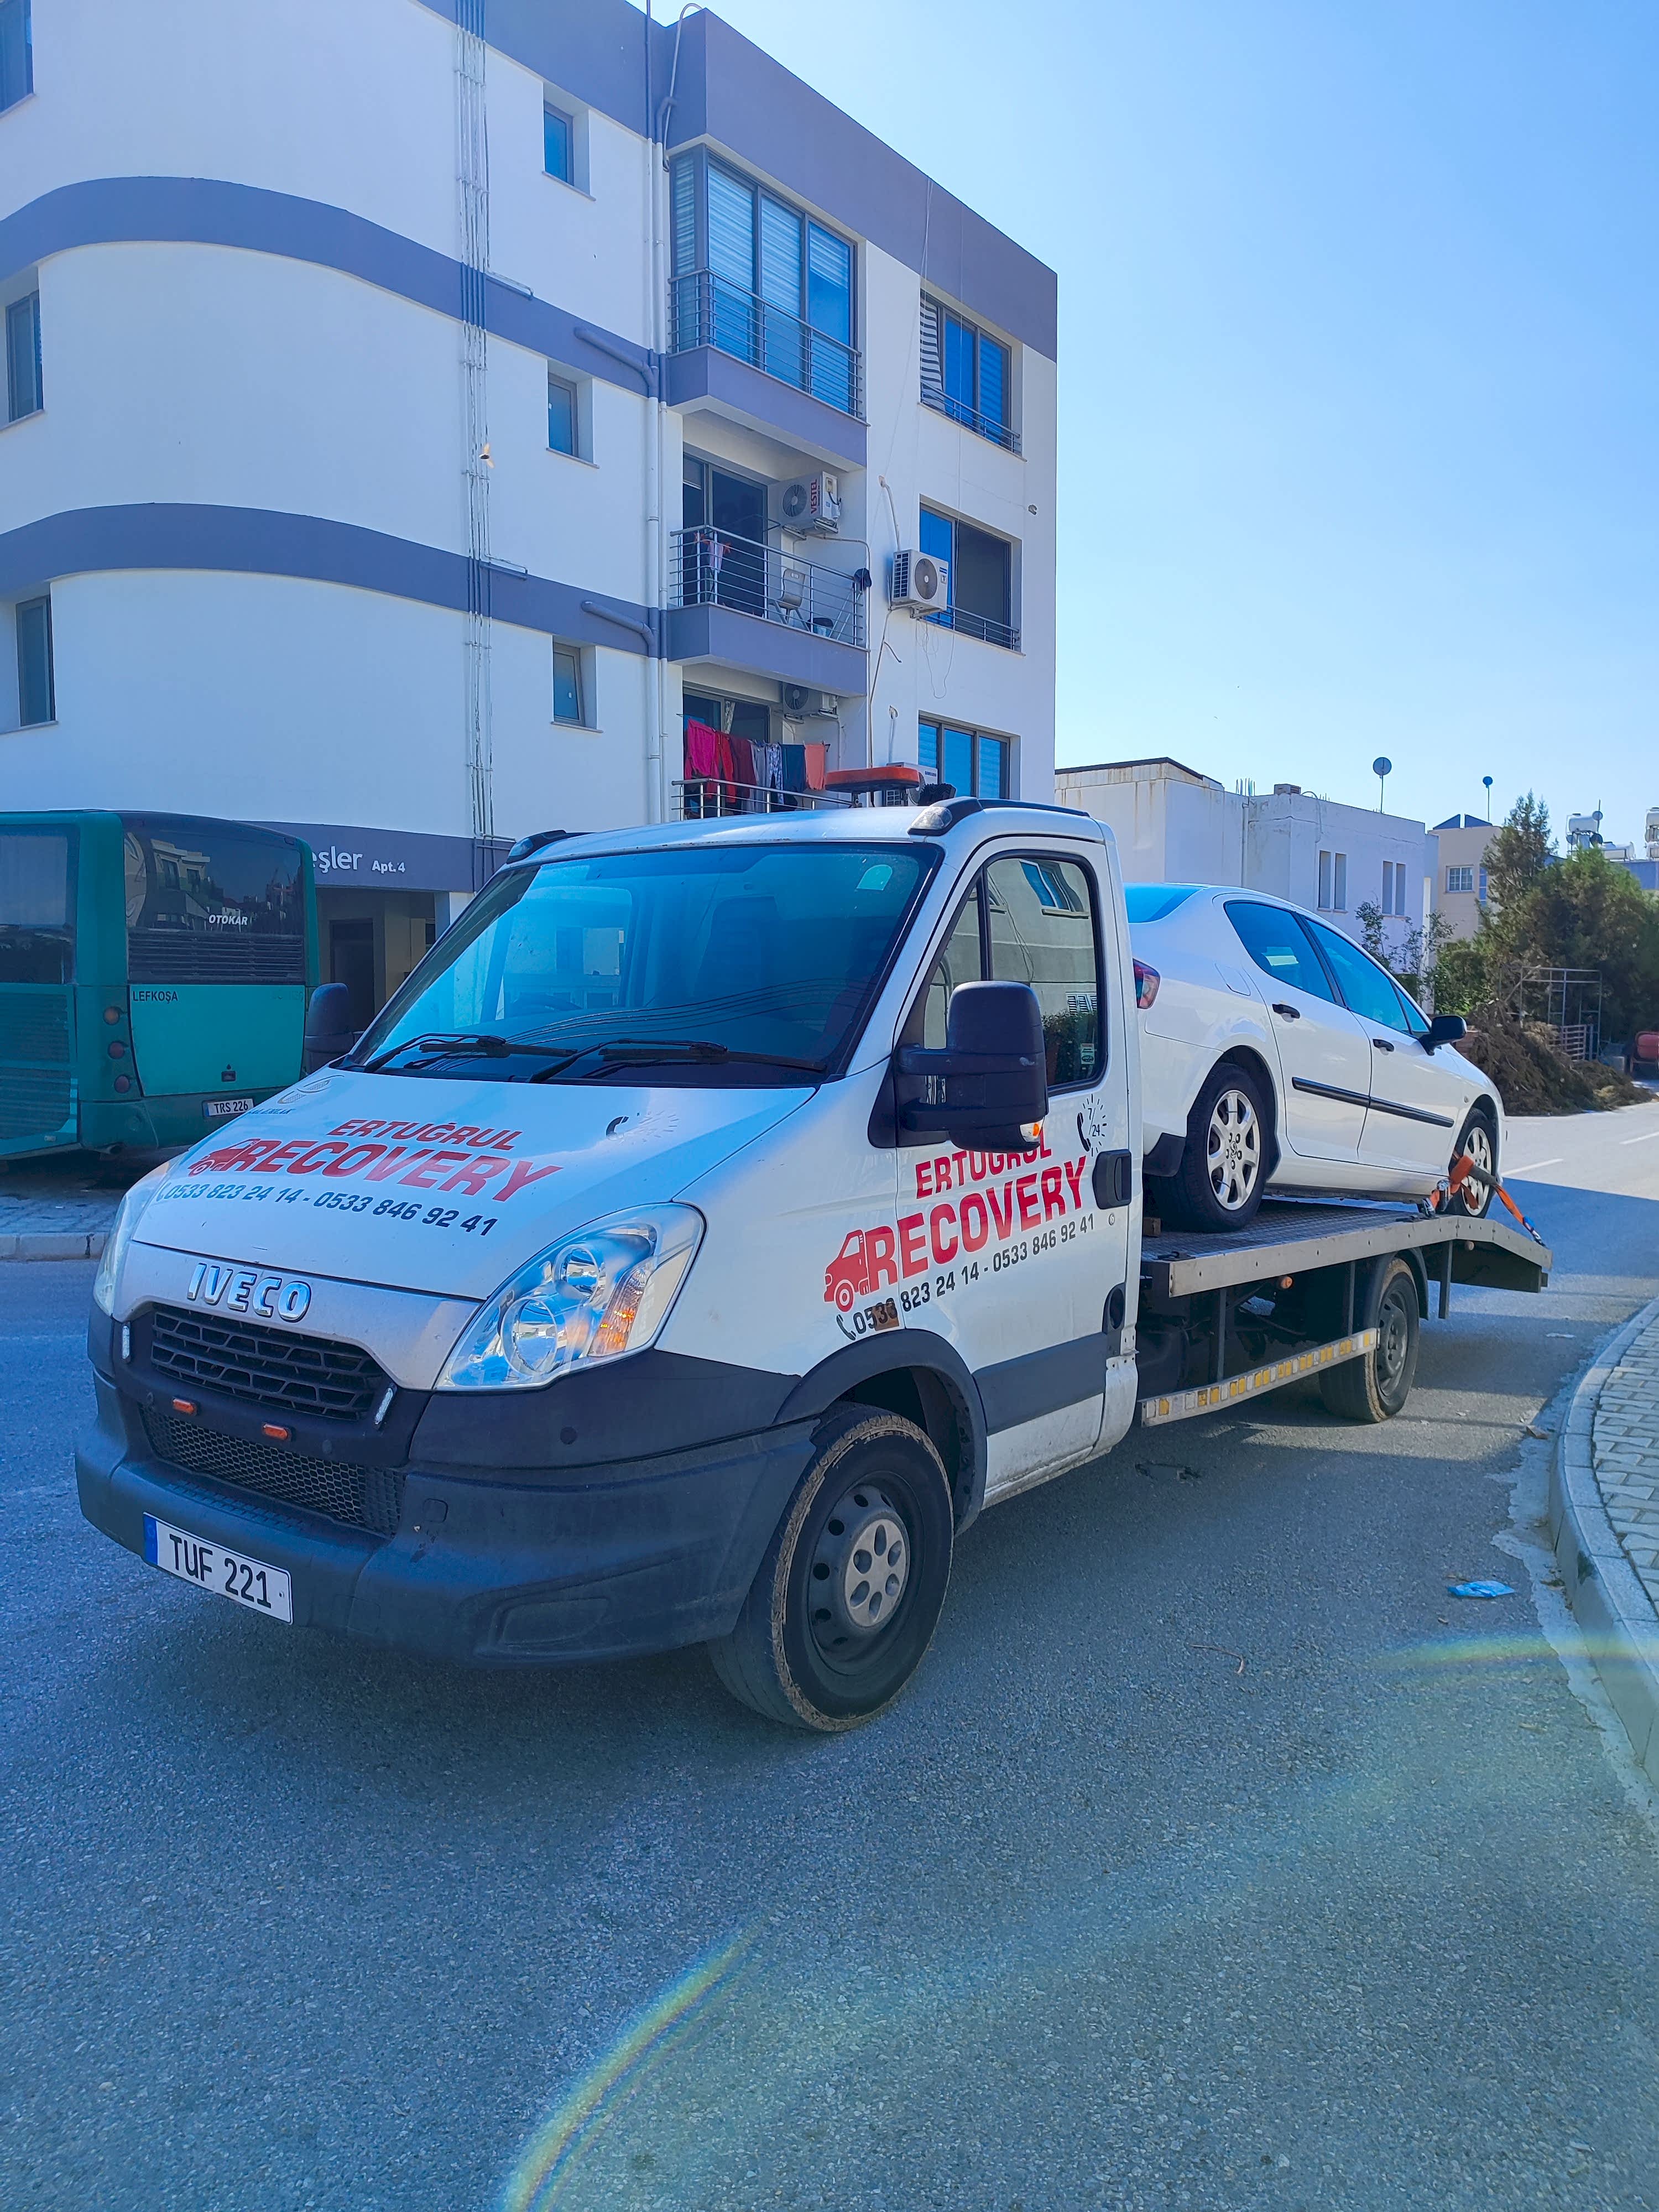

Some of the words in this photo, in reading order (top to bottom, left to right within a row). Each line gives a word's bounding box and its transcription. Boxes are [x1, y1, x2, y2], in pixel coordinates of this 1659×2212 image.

[372, 860, 397, 874] Apt.
[398, 862, 406, 873] 4
[208, 914, 248, 925] OTOKAR
[132, 990, 179, 1004] LEFKOŞA
[214, 1102, 231, 1114] TRS
[233, 1100, 249, 1112] 226
[326, 1119, 523, 1151] ERTUĞRUL
[222, 1140, 564, 1202] RECOVERY
[164, 1183, 210, 1200] 0533
[206, 1183, 247, 1199] 823
[242, 1186, 275, 1201] 24
[274, 1188, 305, 1203] 14
[313, 1192, 374, 1212] 0533
[372, 1199, 422, 1220] 846
[422, 1207, 460, 1228] 92
[460, 1215, 498, 1236] 41
[865, 1155, 1087, 1293] RECOVERY
[187, 1262, 312, 1323] IVECO
[853, 1297, 899, 1335] 0533
[900, 1282, 931, 1312] 823
[936, 1271, 956, 1297] 24
[961, 1261, 979, 1285] 14
[993, 1241, 1028, 1272] 0533
[1032, 1229, 1056, 1255] 846
[1060, 1220, 1076, 1243] 92
[1079, 1213, 1094, 1234] 41
[169, 1533, 213, 1582] TUF
[224, 1557, 272, 1609] 221
